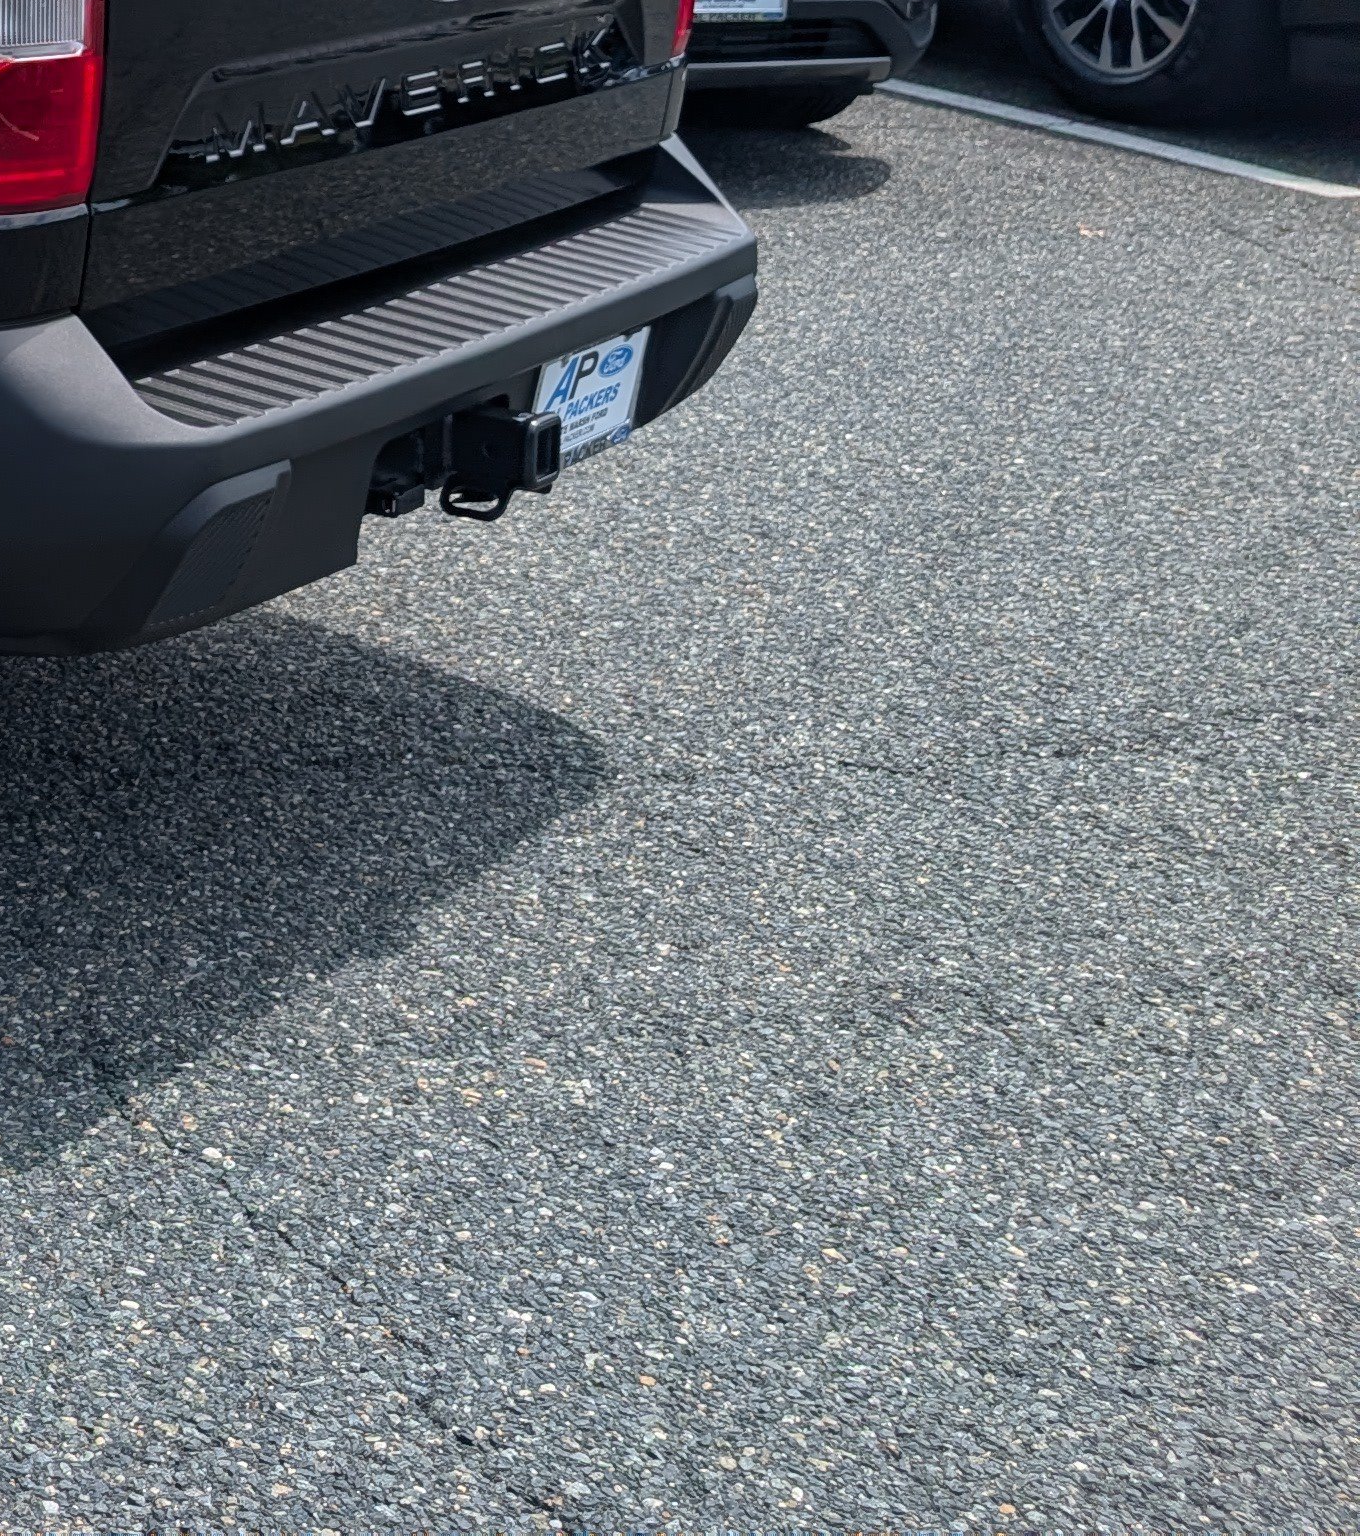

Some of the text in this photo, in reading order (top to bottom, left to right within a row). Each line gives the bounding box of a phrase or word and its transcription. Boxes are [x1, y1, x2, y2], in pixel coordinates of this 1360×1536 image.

[203, 20, 616, 164] MAVERICK
[544, 351, 599, 411] AP
[563, 382, 621, 422] PACKERS
